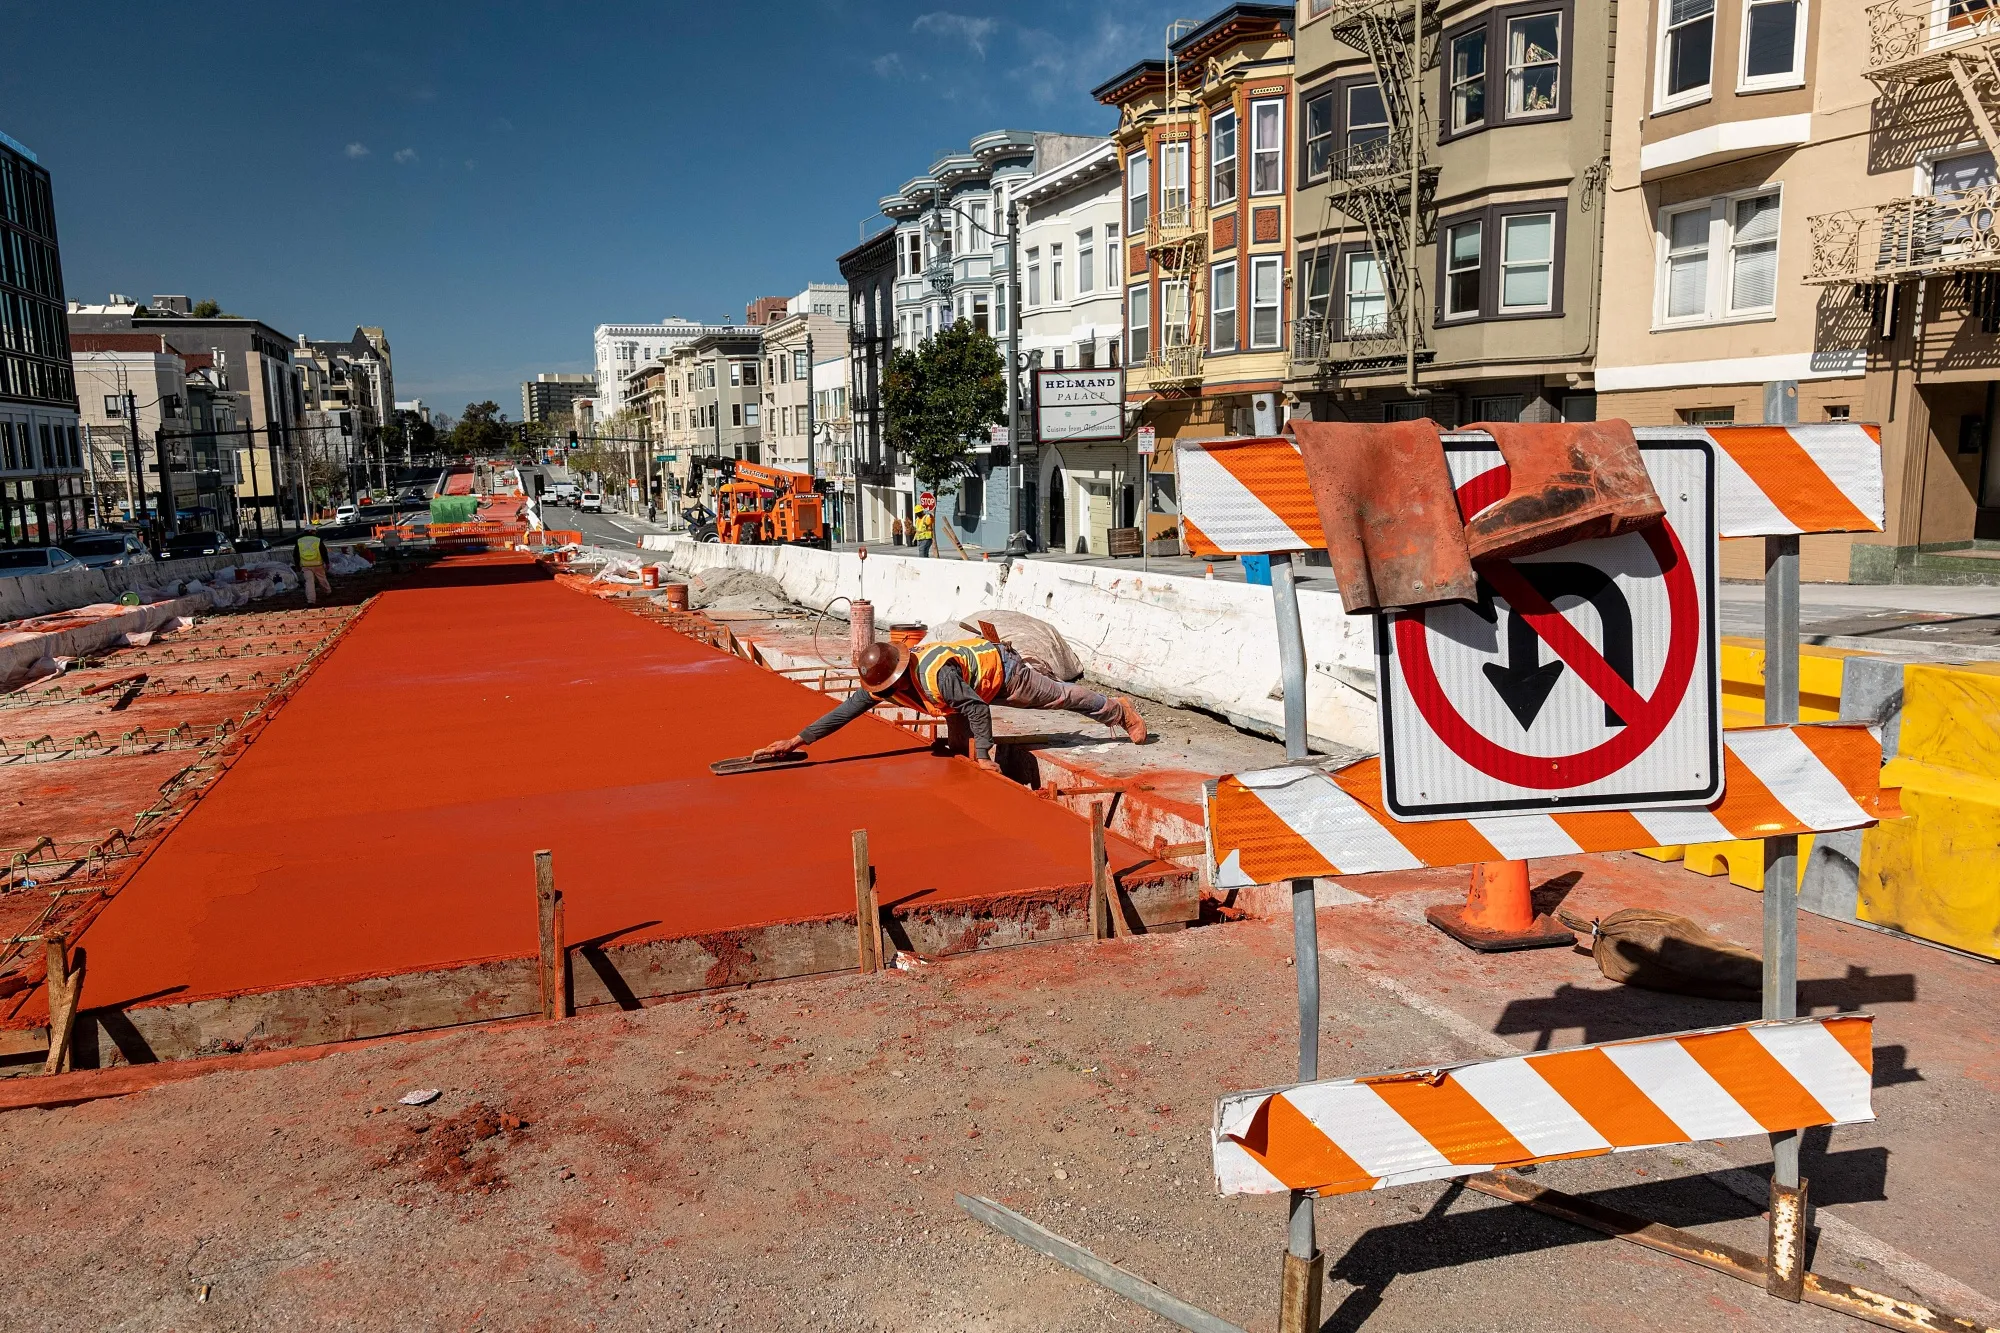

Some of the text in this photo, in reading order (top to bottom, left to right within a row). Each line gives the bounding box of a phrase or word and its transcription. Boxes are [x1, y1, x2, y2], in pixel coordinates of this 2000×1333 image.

[1045, 379, 1115, 389] HELMAND
[1057, 391, 1106, 401] PALACE
[920, 497, 935, 506] STOP
